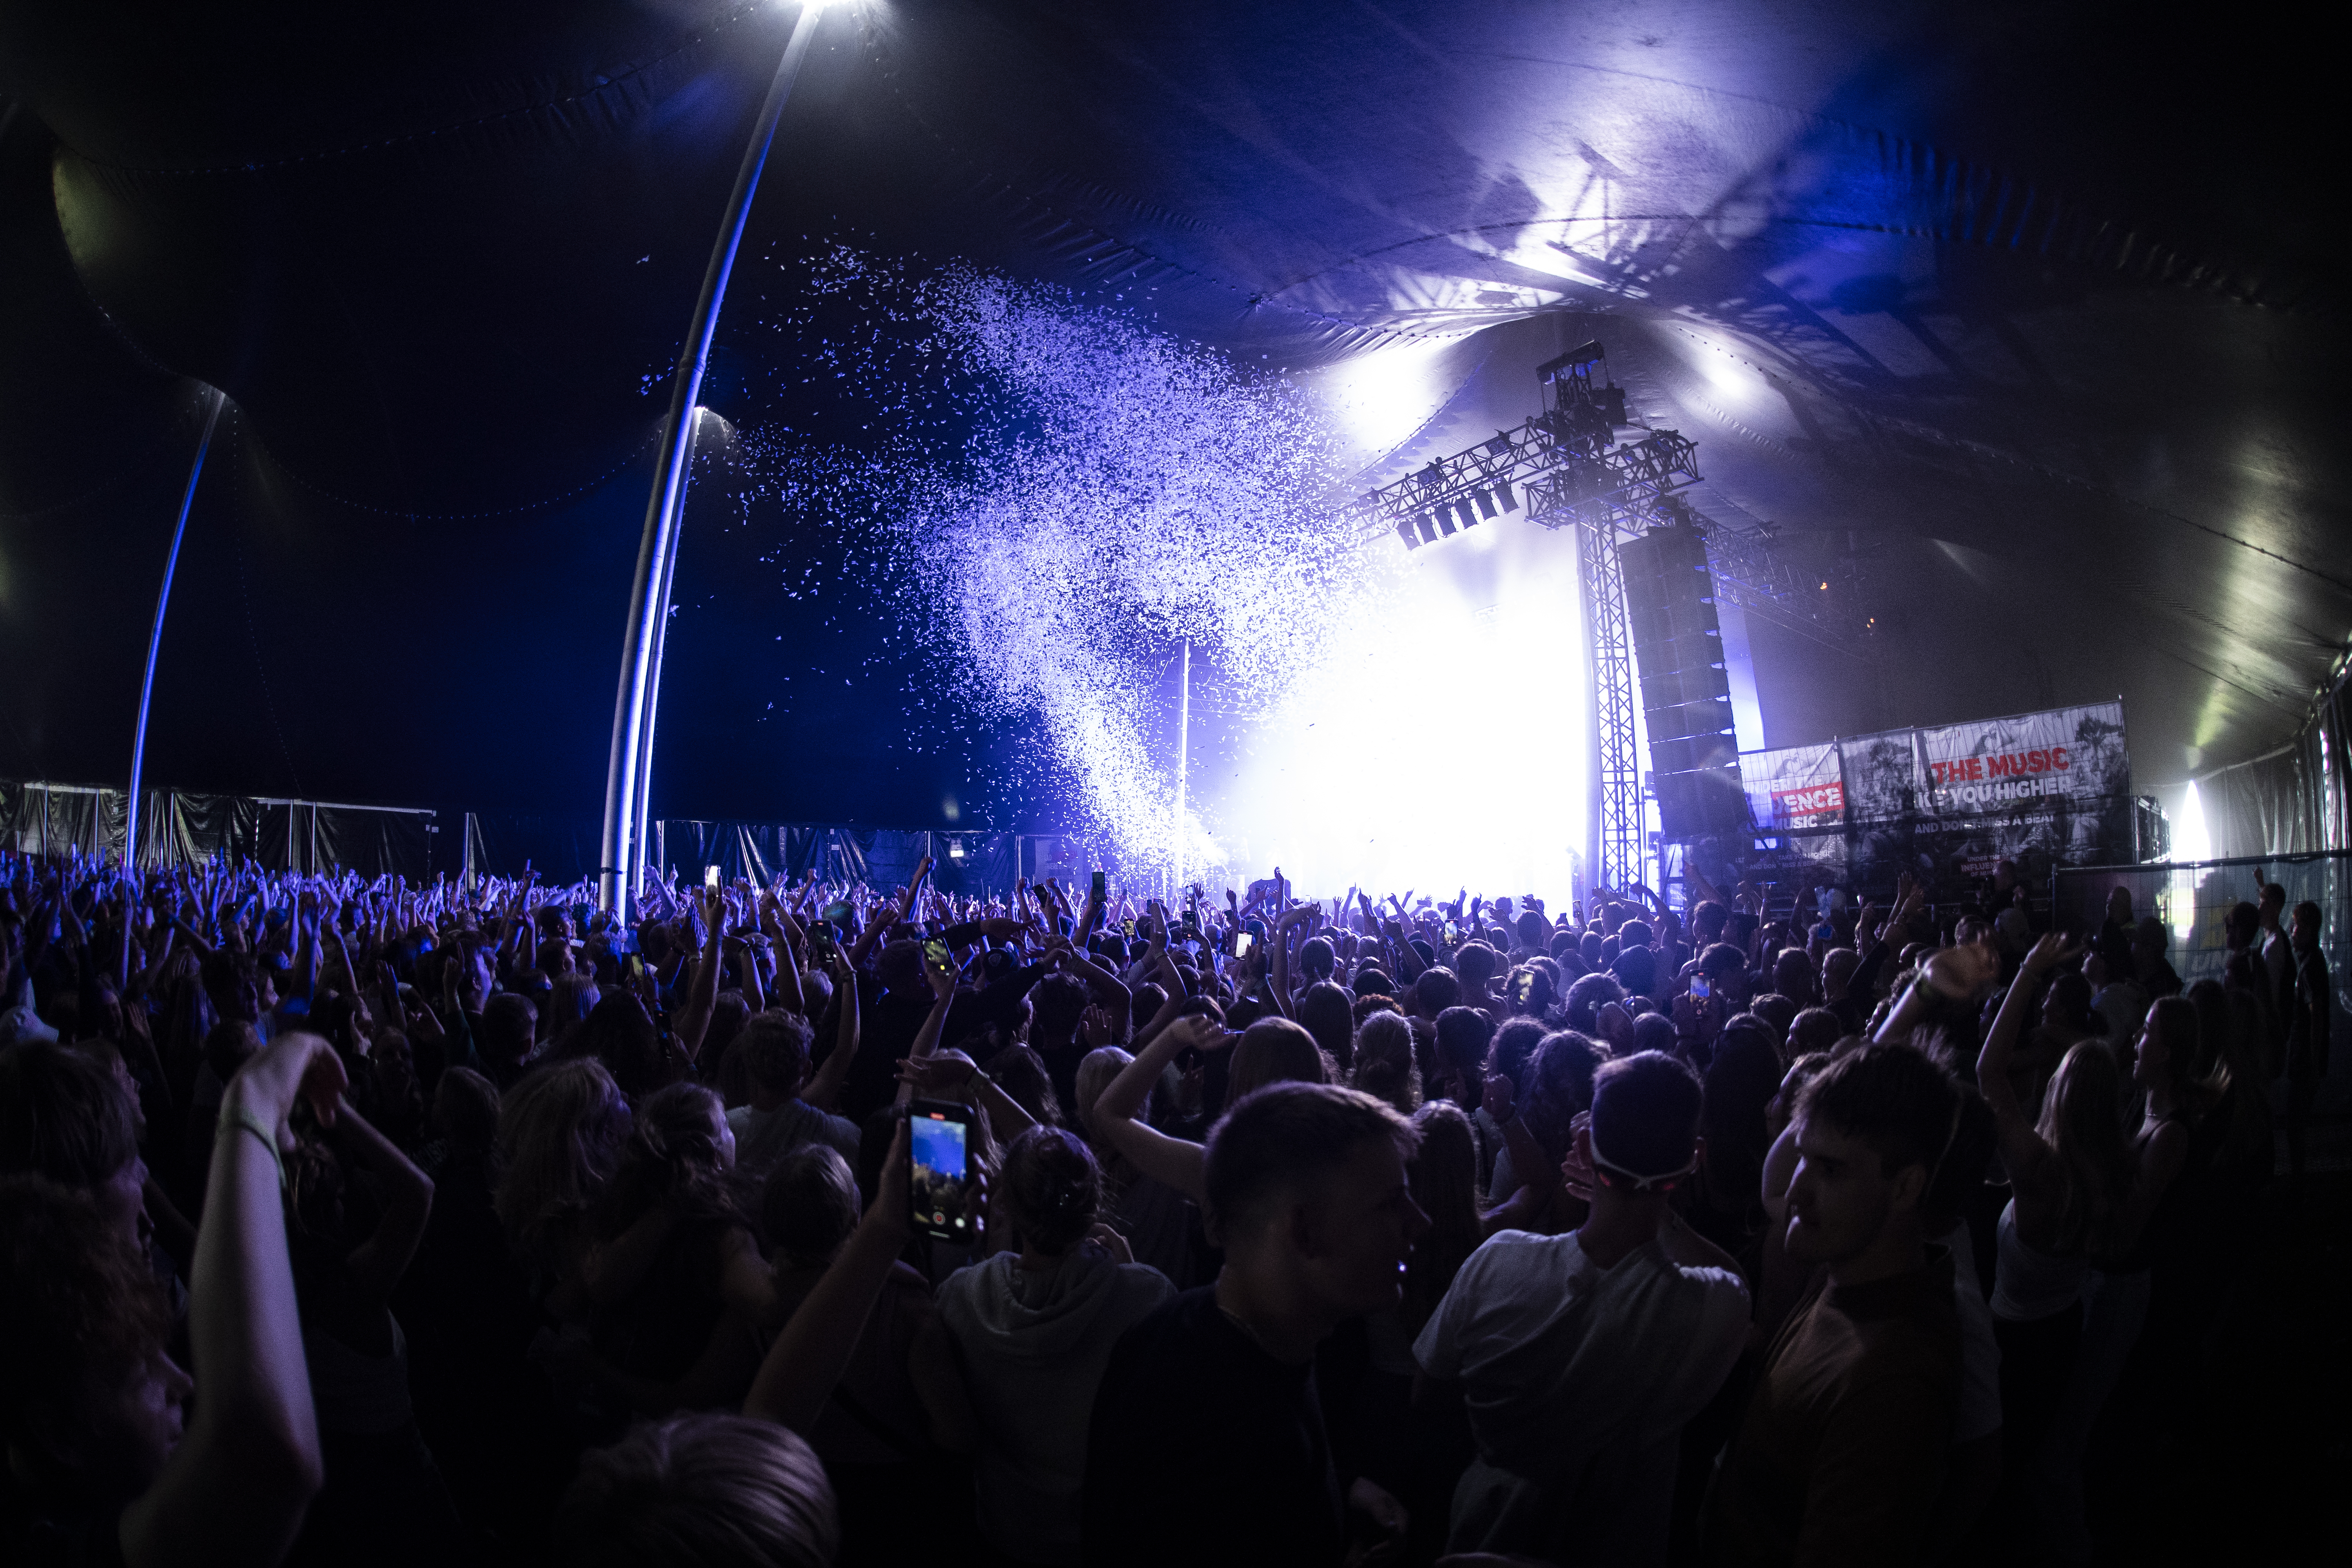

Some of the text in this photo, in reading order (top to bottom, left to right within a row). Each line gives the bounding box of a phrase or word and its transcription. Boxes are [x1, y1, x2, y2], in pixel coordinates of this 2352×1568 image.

[1931, 747, 2069, 784] THE MUSIC
[1949, 784, 1992, 804] YOU
[1995, 776, 2071, 800] HIGHER
[1915, 822, 1938, 834] AND
[2012, 815, 2022, 826] A
